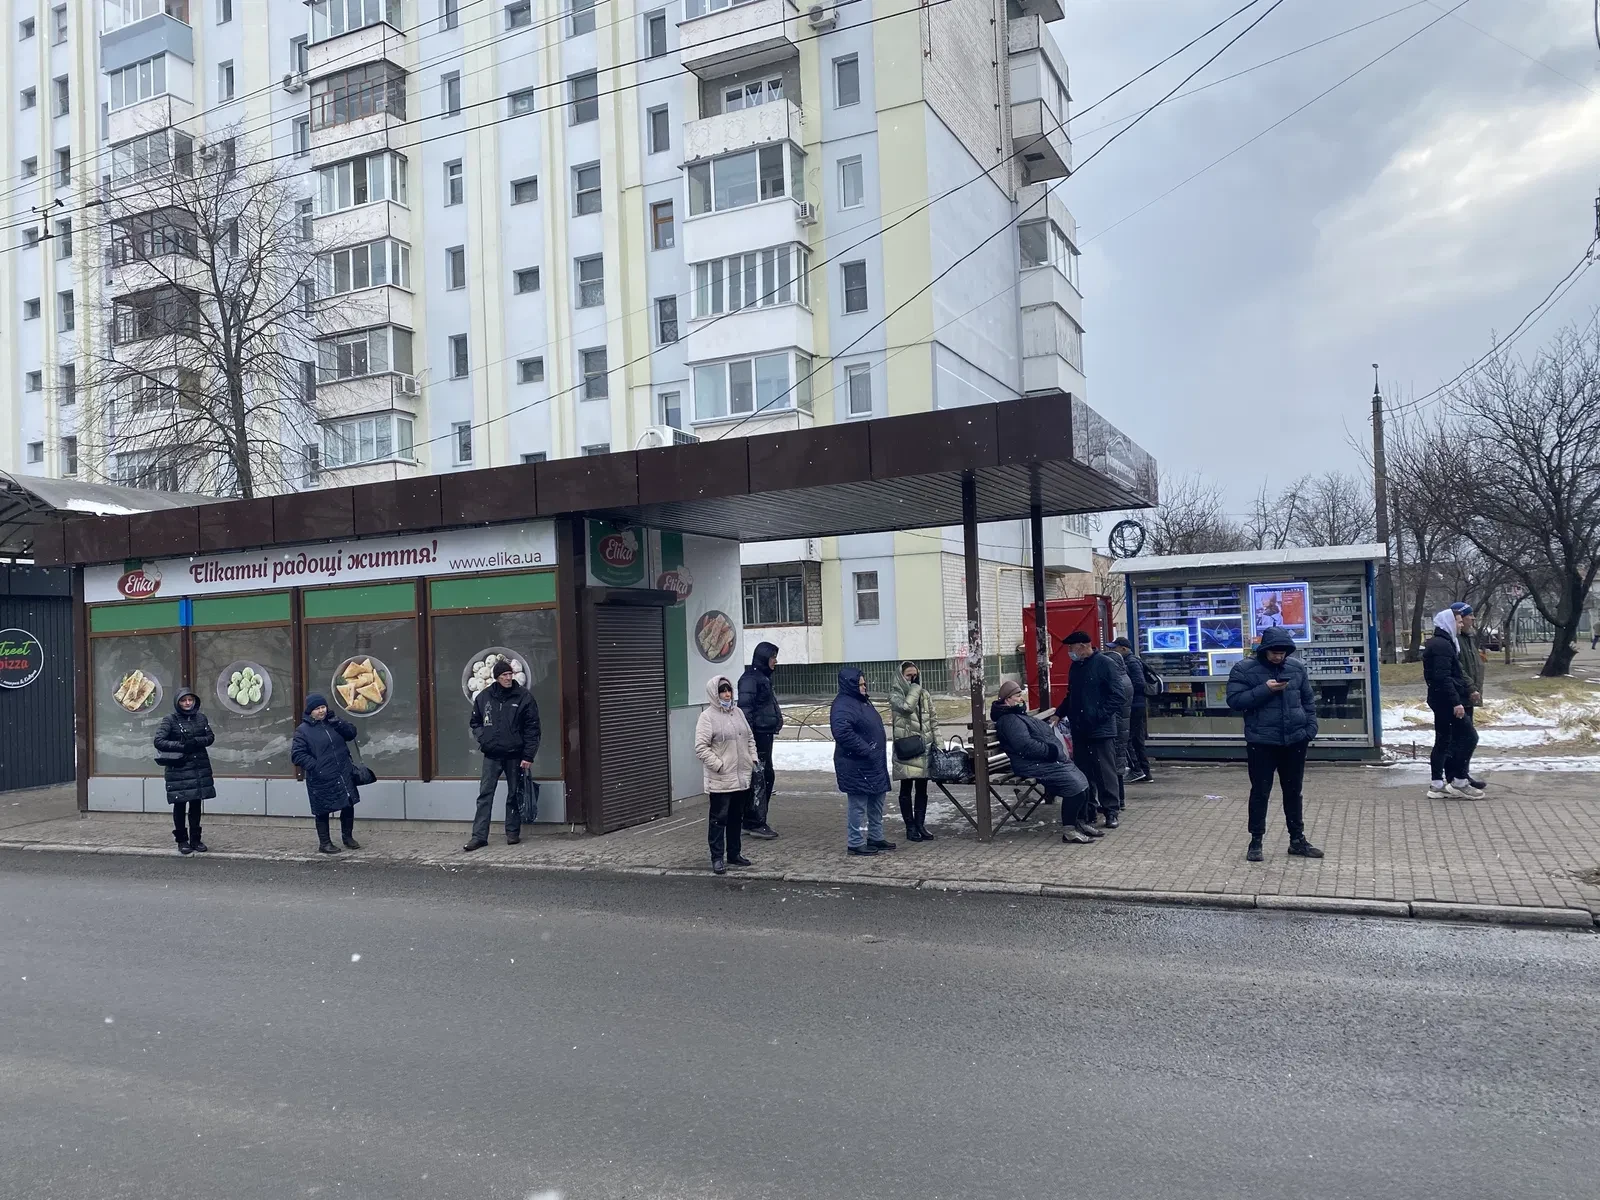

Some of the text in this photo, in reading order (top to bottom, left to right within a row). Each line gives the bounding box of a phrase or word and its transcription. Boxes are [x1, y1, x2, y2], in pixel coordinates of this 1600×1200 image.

[605, 538, 633, 561] Elika
[272, 549, 343, 584] радощі
[347, 539, 438, 570] життя!
[448, 551, 543, 570] www.elika.ua
[124, 574, 155, 594] Elika
[662, 575, 688, 595] Elika
[0, 640, 37, 656] treet
